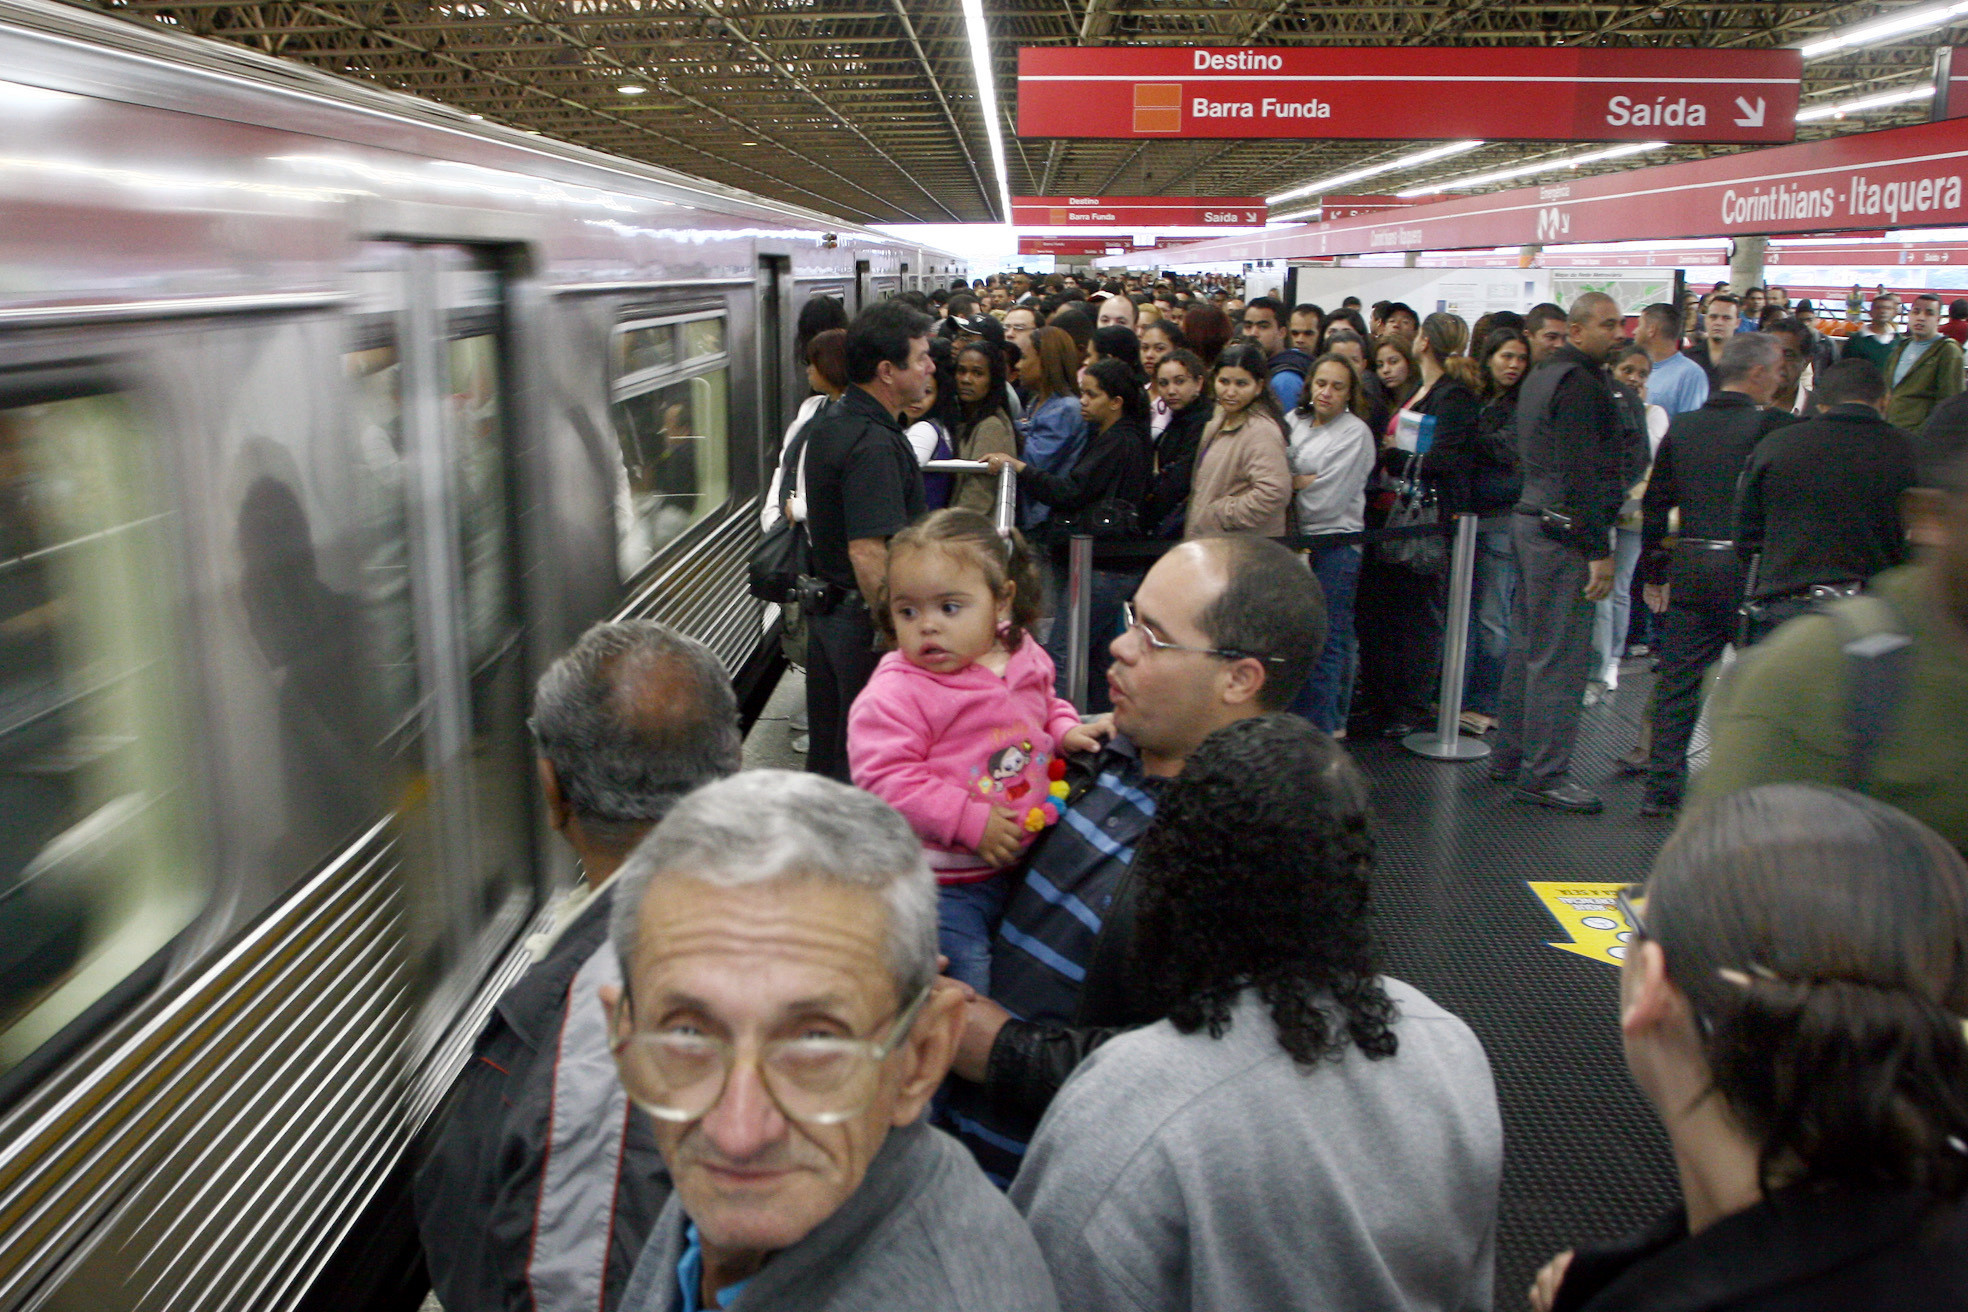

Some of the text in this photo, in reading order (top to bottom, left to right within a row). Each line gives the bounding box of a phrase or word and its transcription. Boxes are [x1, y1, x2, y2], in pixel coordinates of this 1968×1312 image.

[1194, 50, 1283, 70] Destino
[1192, 98, 1331, 118] Barra Funda
[1606, 96, 1706, 127] Saída
[1722, 183, 1834, 225] Corinthians
[1849, 176, 1961, 223] Itaquera
[1069, 212, 1116, 221] Barra Funda
[1204, 211, 1239, 223] Saída
